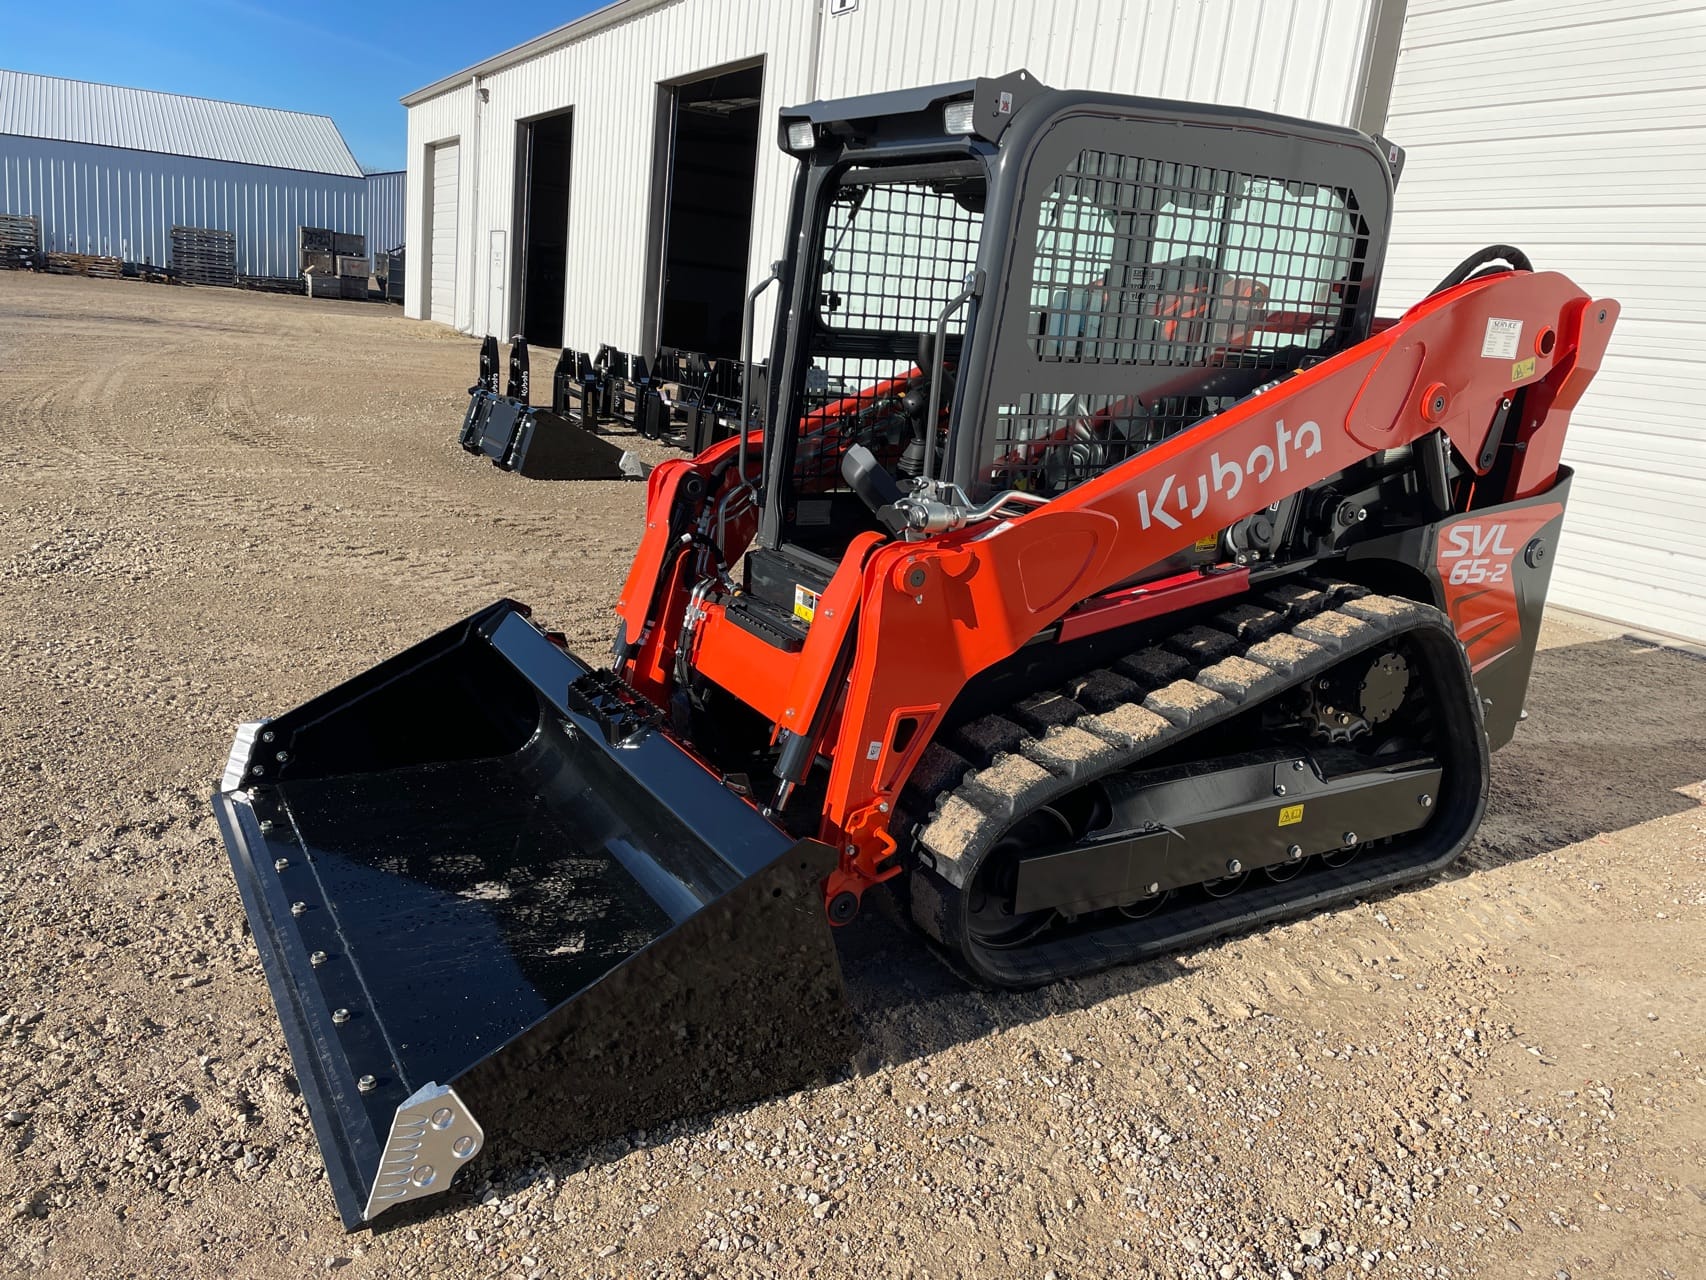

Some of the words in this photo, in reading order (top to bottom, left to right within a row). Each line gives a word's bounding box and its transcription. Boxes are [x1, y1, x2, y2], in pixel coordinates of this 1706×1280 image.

[1494, 320, 1518, 330] SERVICE
[521, 370, 529, 397] Kubota
[1137, 418, 1322, 531] Kubota
[1441, 524, 1514, 557] SVL
[1449, 558, 1508, 586] 65-2
